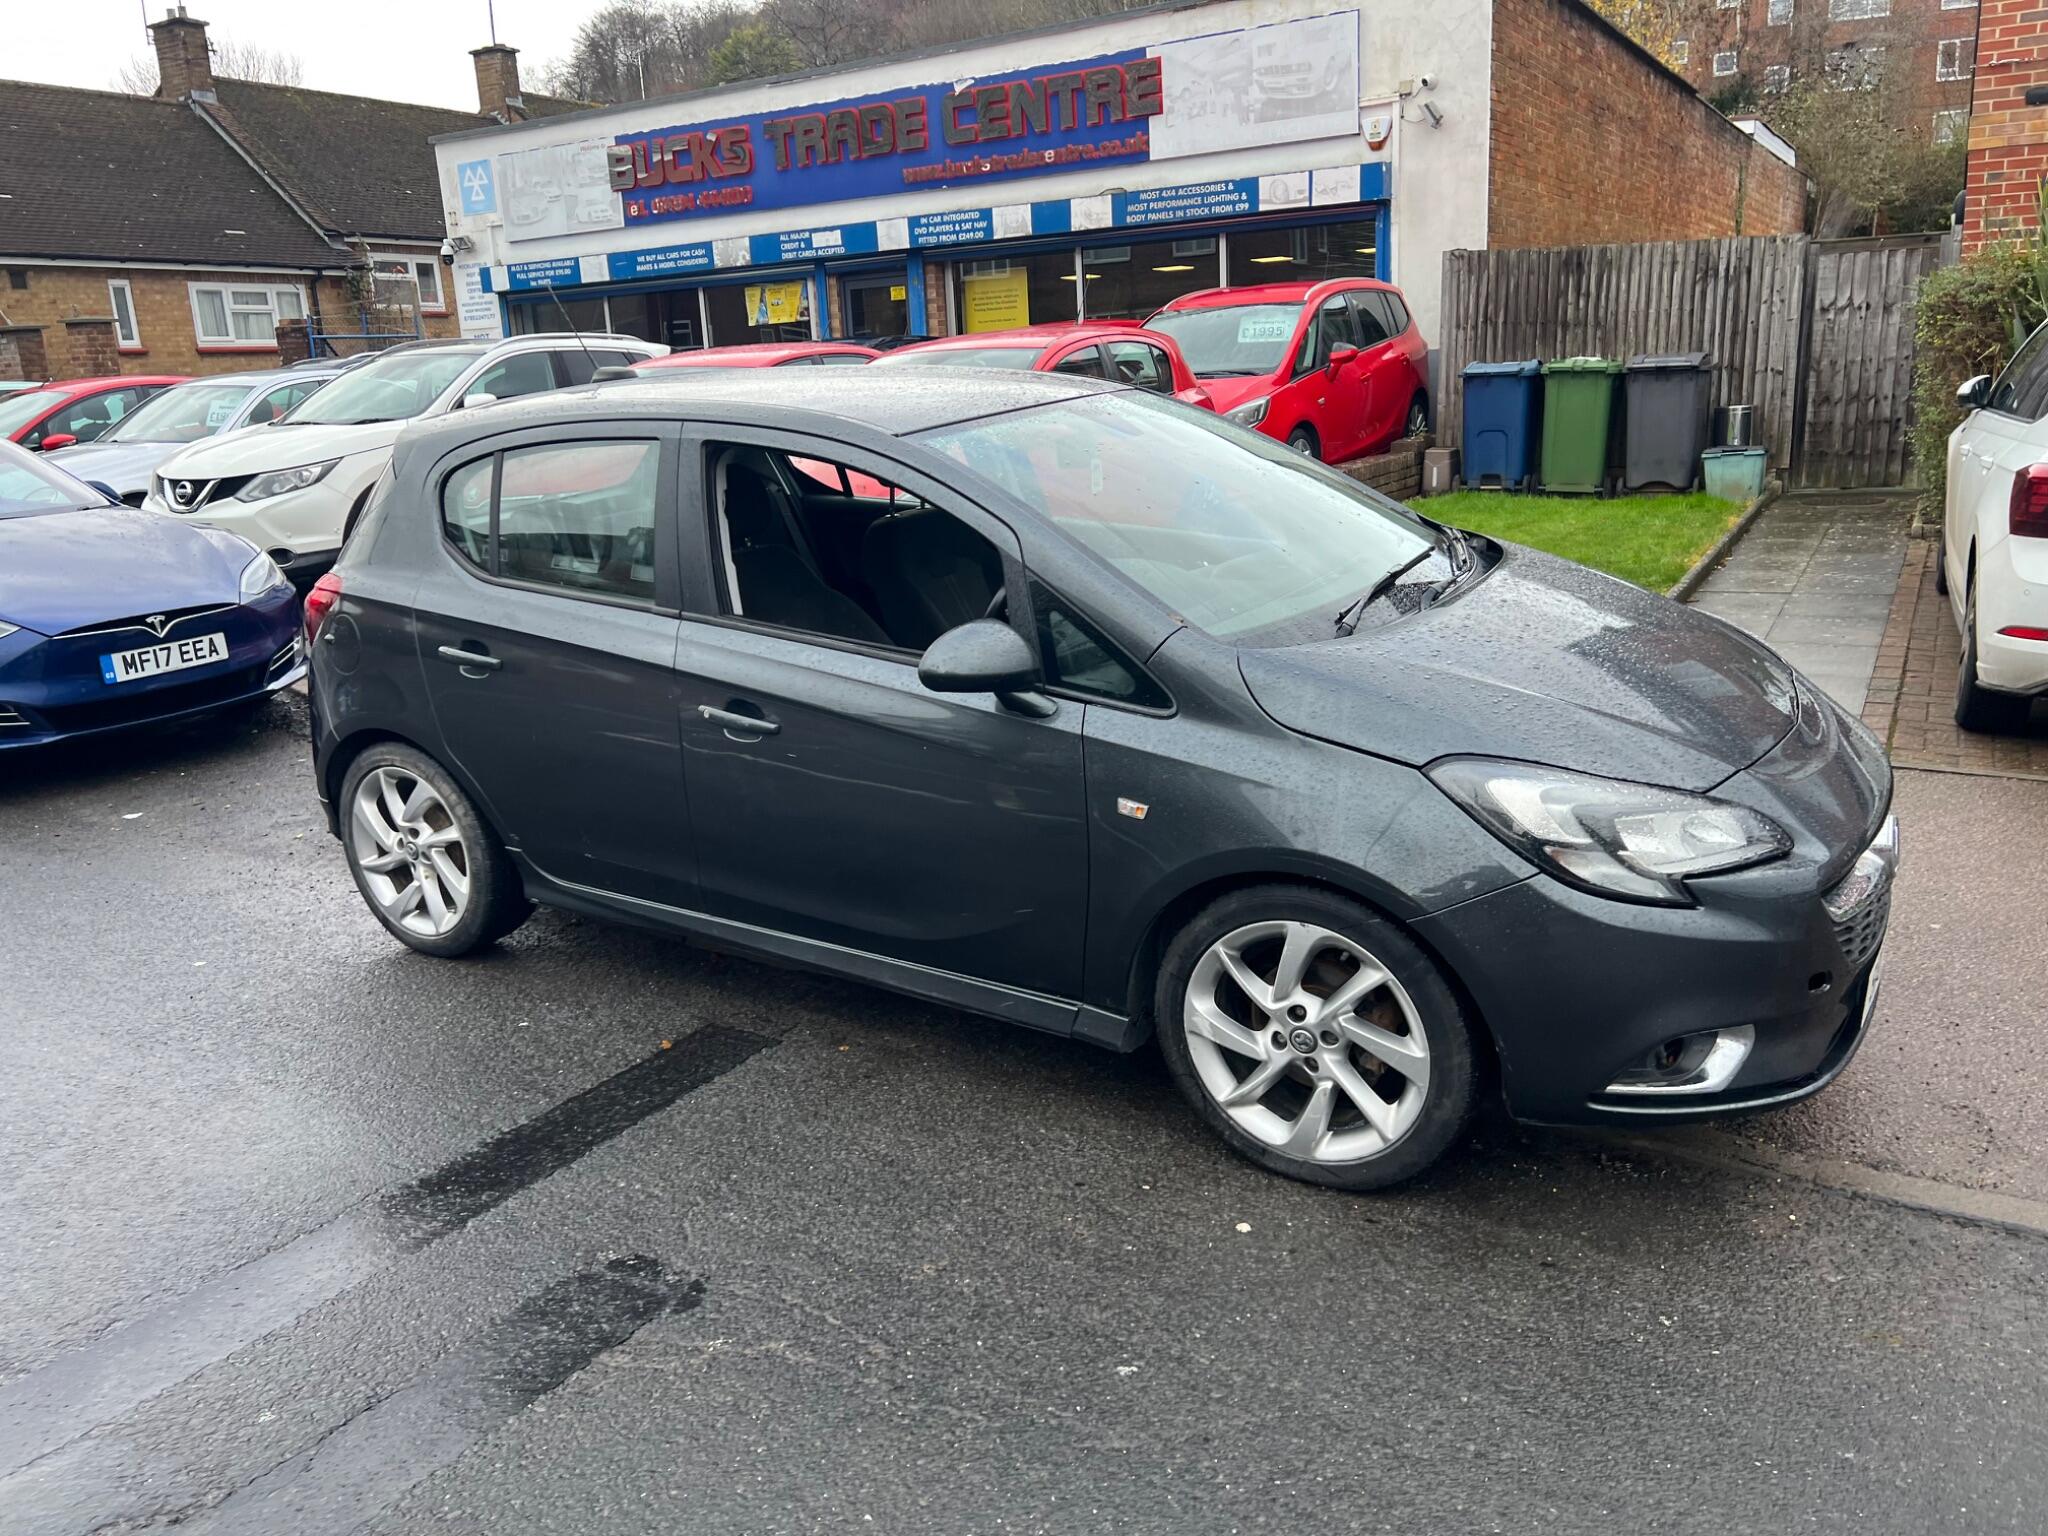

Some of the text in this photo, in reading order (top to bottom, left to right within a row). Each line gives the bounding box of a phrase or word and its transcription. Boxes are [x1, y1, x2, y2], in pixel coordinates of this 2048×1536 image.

[607, 124, 755, 192] BUCKS
[763, 96, 928, 171] TRADE
[942, 56, 1163, 146] CENTRE
[1139, 182, 1234, 200] MOST 4X4 ACCESSORIES &
[1127, 192, 1247, 212] MOST PERFORMANCE LIGHTING &
[942, 211, 980, 222] INTEGRATED
[1126, 214, 1145, 223] BODY
[1147, 211, 1174, 221] PANELS
[1186, 207, 1210, 216] STOCK
[1211, 204, 1233, 214] FROM
[1235, 202, 1249, 211] £99
[790, 231, 810, 239] MAJOR
[914, 227, 928, 235] DVD
[928, 224, 954, 233] PLAYERS
[954, 223, 960, 231] &
[918, 236, 938, 244] FITTED
[939, 234, 957, 243] FROM
[691, 248, 706, 256] CASH
[780, 242, 799, 250] CREDIT
[782, 247, 845, 260] DEBIT CARDS ACCEPTED
[677, 257, 709, 267] CONSIDERED
[121, 636, 220, 675] MF17 EEA
